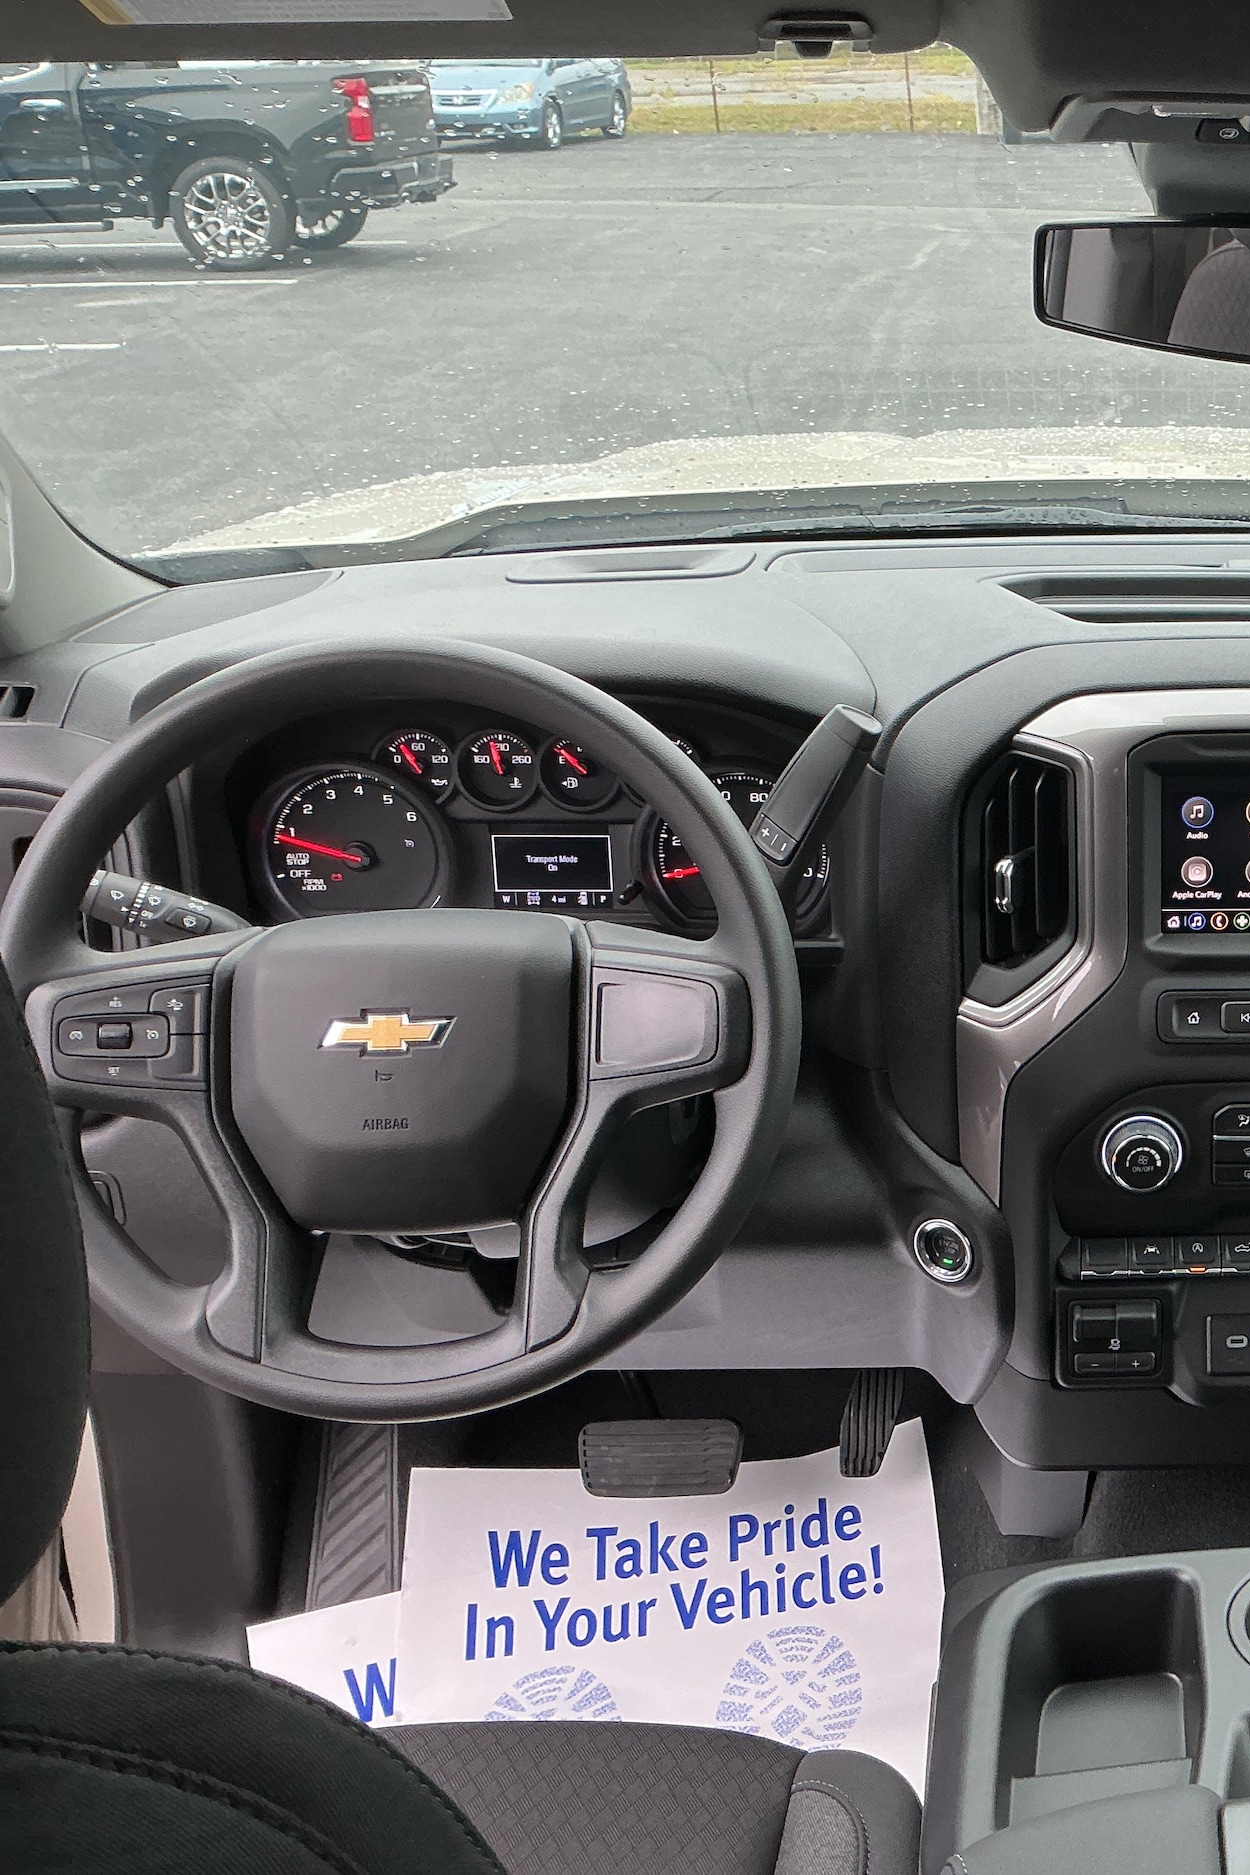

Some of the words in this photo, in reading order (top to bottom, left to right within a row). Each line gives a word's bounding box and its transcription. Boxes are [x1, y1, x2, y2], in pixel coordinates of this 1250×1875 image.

[411, 743, 425, 751] 60
[393, 755, 402, 764] 0
[431, 755, 449, 764] 120
[473, 755, 490, 764] 160
[511, 755, 532, 764] 260
[558, 755, 566, 764] E
[325, 789, 337, 800] 3
[353, 785, 364, 796] 4
[382, 794, 394, 805] 5
[302, 804, 314, 815] 2
[406, 811, 417, 822] 6
[288, 827, 296, 837] 1
[1186, 831, 1209, 840] Audio
[525, 855, 558, 865] Transport
[558, 855, 578, 864] Mode
[547, 864, 558, 872] On
[290, 869, 312, 878] OFF
[502, 895, 511, 903] W
[600, 895, 607, 903] P
[1172, 890, 1194, 900] Apple
[1195, 890, 1222, 900] CarPlay
[362, 1118, 409, 1131] AIRBAG
[488, 1529, 570, 1588] We
[586, 1520, 709, 1581] Take
[729, 1497, 862, 1563] Pride
[465, 1603, 514, 1661] In
[533, 1596, 657, 1652] Your
[670, 1543, 884, 1630] Vehicle!
